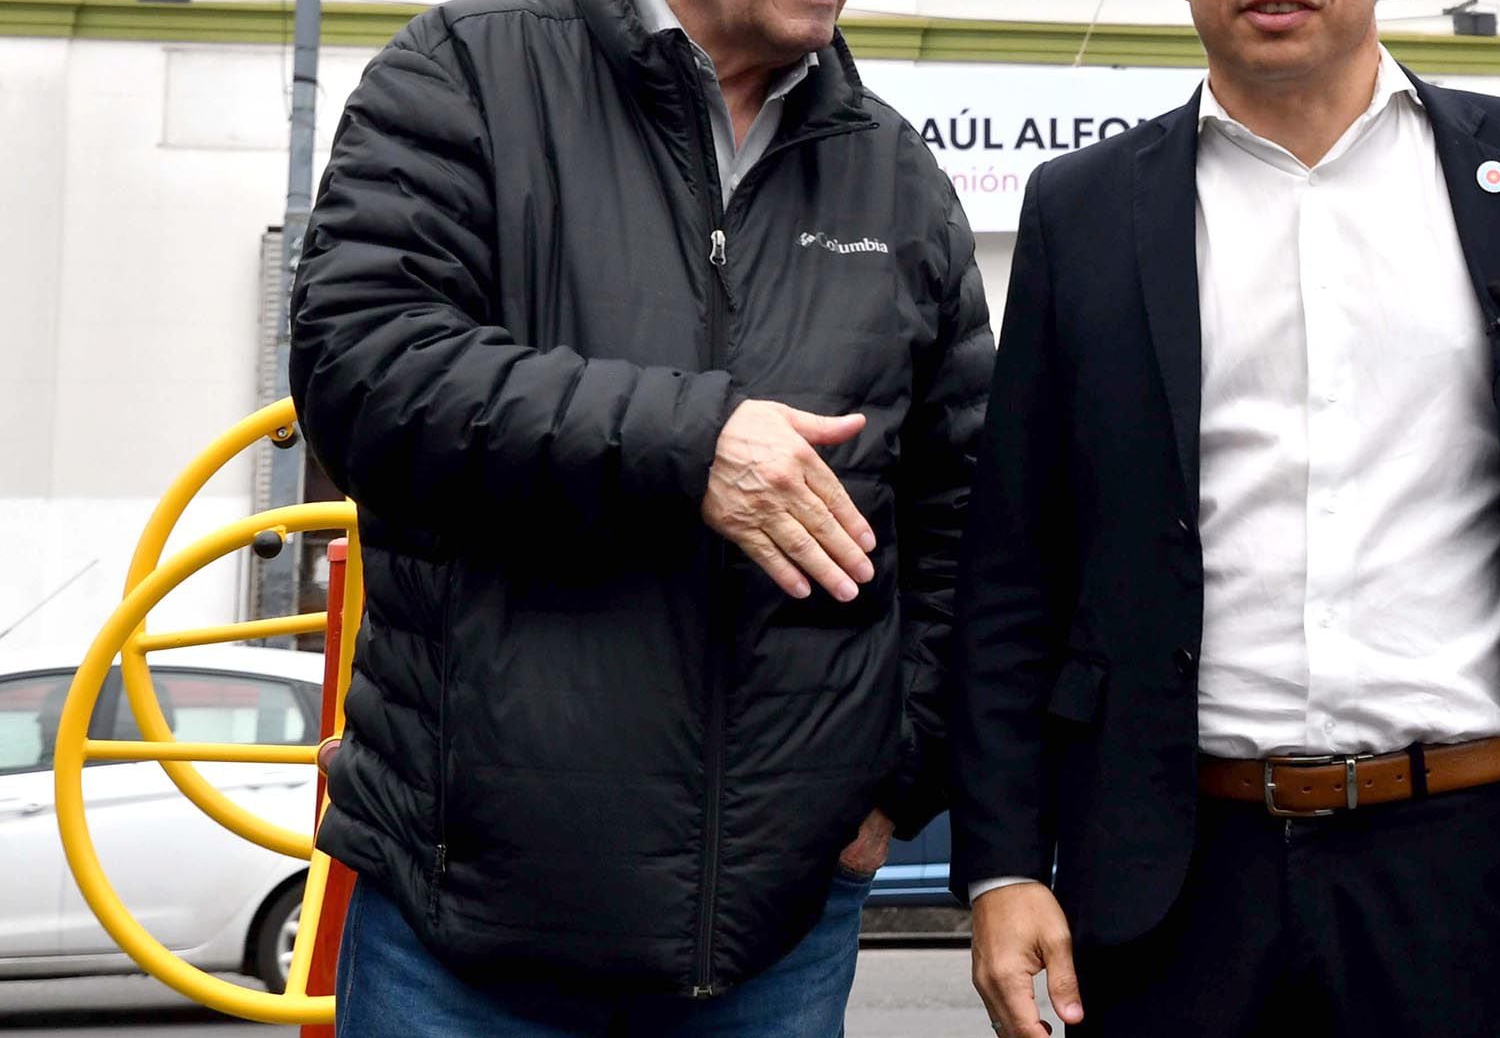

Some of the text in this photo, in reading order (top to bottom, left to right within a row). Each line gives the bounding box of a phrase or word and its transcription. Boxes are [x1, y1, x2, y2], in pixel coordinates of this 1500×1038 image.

[920, 108, 1147, 150] AÚL ALFO
[943, 165, 1018, 193] nión
